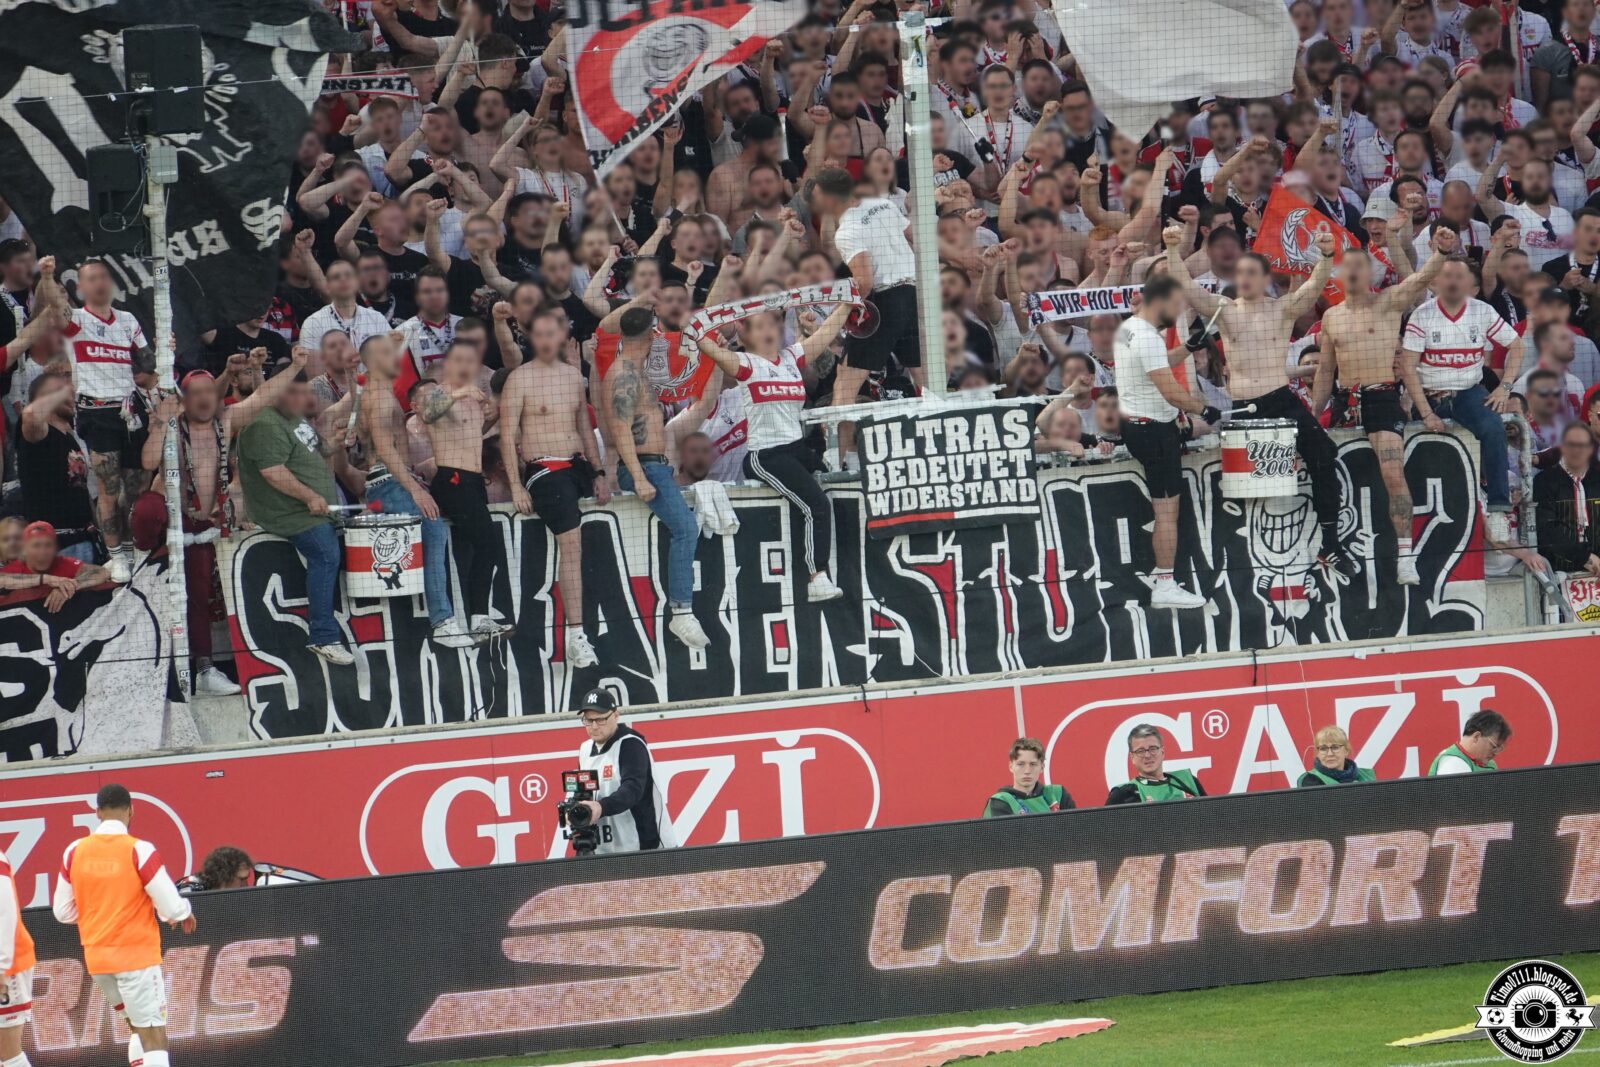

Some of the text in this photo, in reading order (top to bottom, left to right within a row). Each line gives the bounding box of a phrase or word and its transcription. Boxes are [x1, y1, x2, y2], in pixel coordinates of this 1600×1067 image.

[1048, 290, 1086, 315] WIR
[862, 408, 1031, 463] ULTRAS
[866, 448, 1033, 492] BEDEUTET
[867, 477, 1038, 517] WIDERSTAND
[868, 822, 1513, 972] COMFORT
